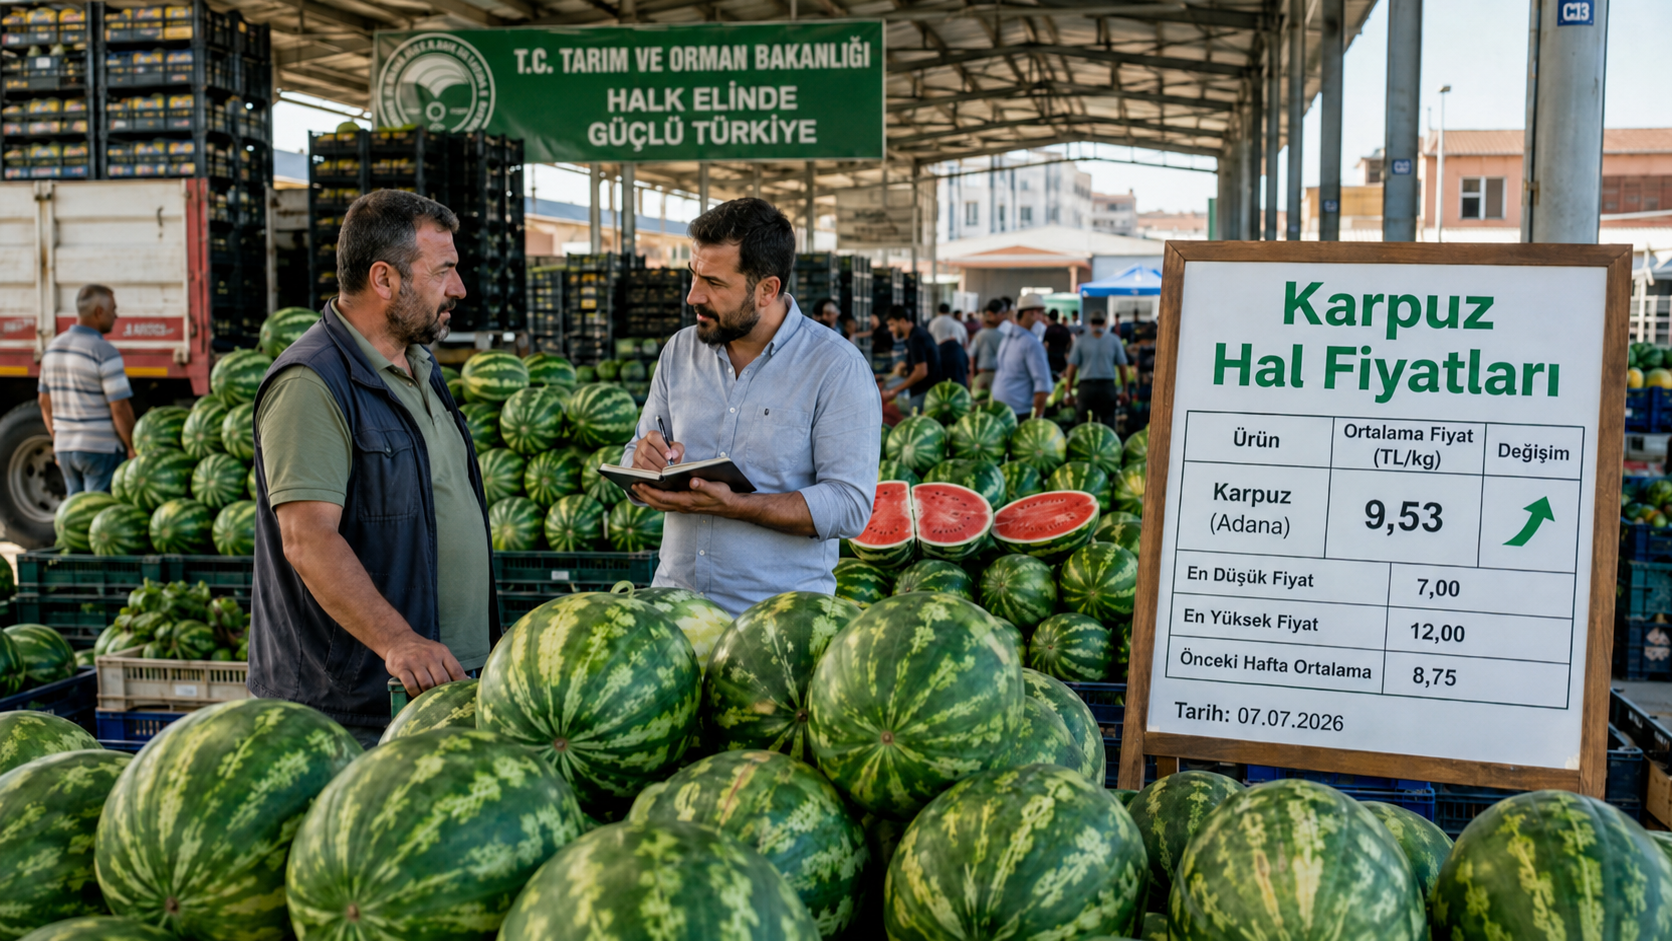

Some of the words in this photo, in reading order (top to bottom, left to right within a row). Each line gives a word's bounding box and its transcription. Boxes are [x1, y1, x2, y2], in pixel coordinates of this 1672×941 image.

[514, 48, 553, 74] T.C.
[559, 47, 628, 73] TARIM
[635, 46, 663, 72] VE
[669, 44, 747, 72] ORMAN
[754, 35, 871, 70] BAKANLIĞI
[607, 87, 685, 113] HALK
[693, 81, 798, 111] ELİNDE
[588, 117, 684, 152] GÜÇLÜ
[692, 114, 818, 145] TÜRKİYE
[1283, 280, 1495, 341] Karpuz
[1213, 342, 1305, 390] Hal
[1323, 345, 1560, 404] Fiyatları
[1233, 426, 1280, 449] Ürün
[1343, 423, 1425, 443] Ortalama
[1430, 426, 1474, 447] Fiyat
[1373, 447, 1442, 471] (TL/kg)
[1497, 442, 1570, 464] Değişim
[1213, 482, 1292, 508] Karpuz
[1210, 512, 1291, 540] (Adana)
[1364, 498, 1444, 537] 9,53
[1187, 565, 1208, 581] En
[1213, 567, 1268, 587] Düşük
[1272, 570, 1314, 590] Fiyat
[1417, 577, 1461, 600] 7,00
[1183, 607, 1205, 624] En
[1210, 609, 1272, 630] Yüksek
[1277, 613, 1319, 634] Fiyat
[1410, 622, 1466, 645] 12,00
[1179, 647, 1239, 671] Önceki
[1243, 654, 1289, 675] Hafta
[1293, 658, 1373, 681] Ortalama
[1412, 666, 1457, 689] 8,75
[1174, 700, 1231, 724] Tarih:
[1237, 706, 1345, 733] 07.07.2026
